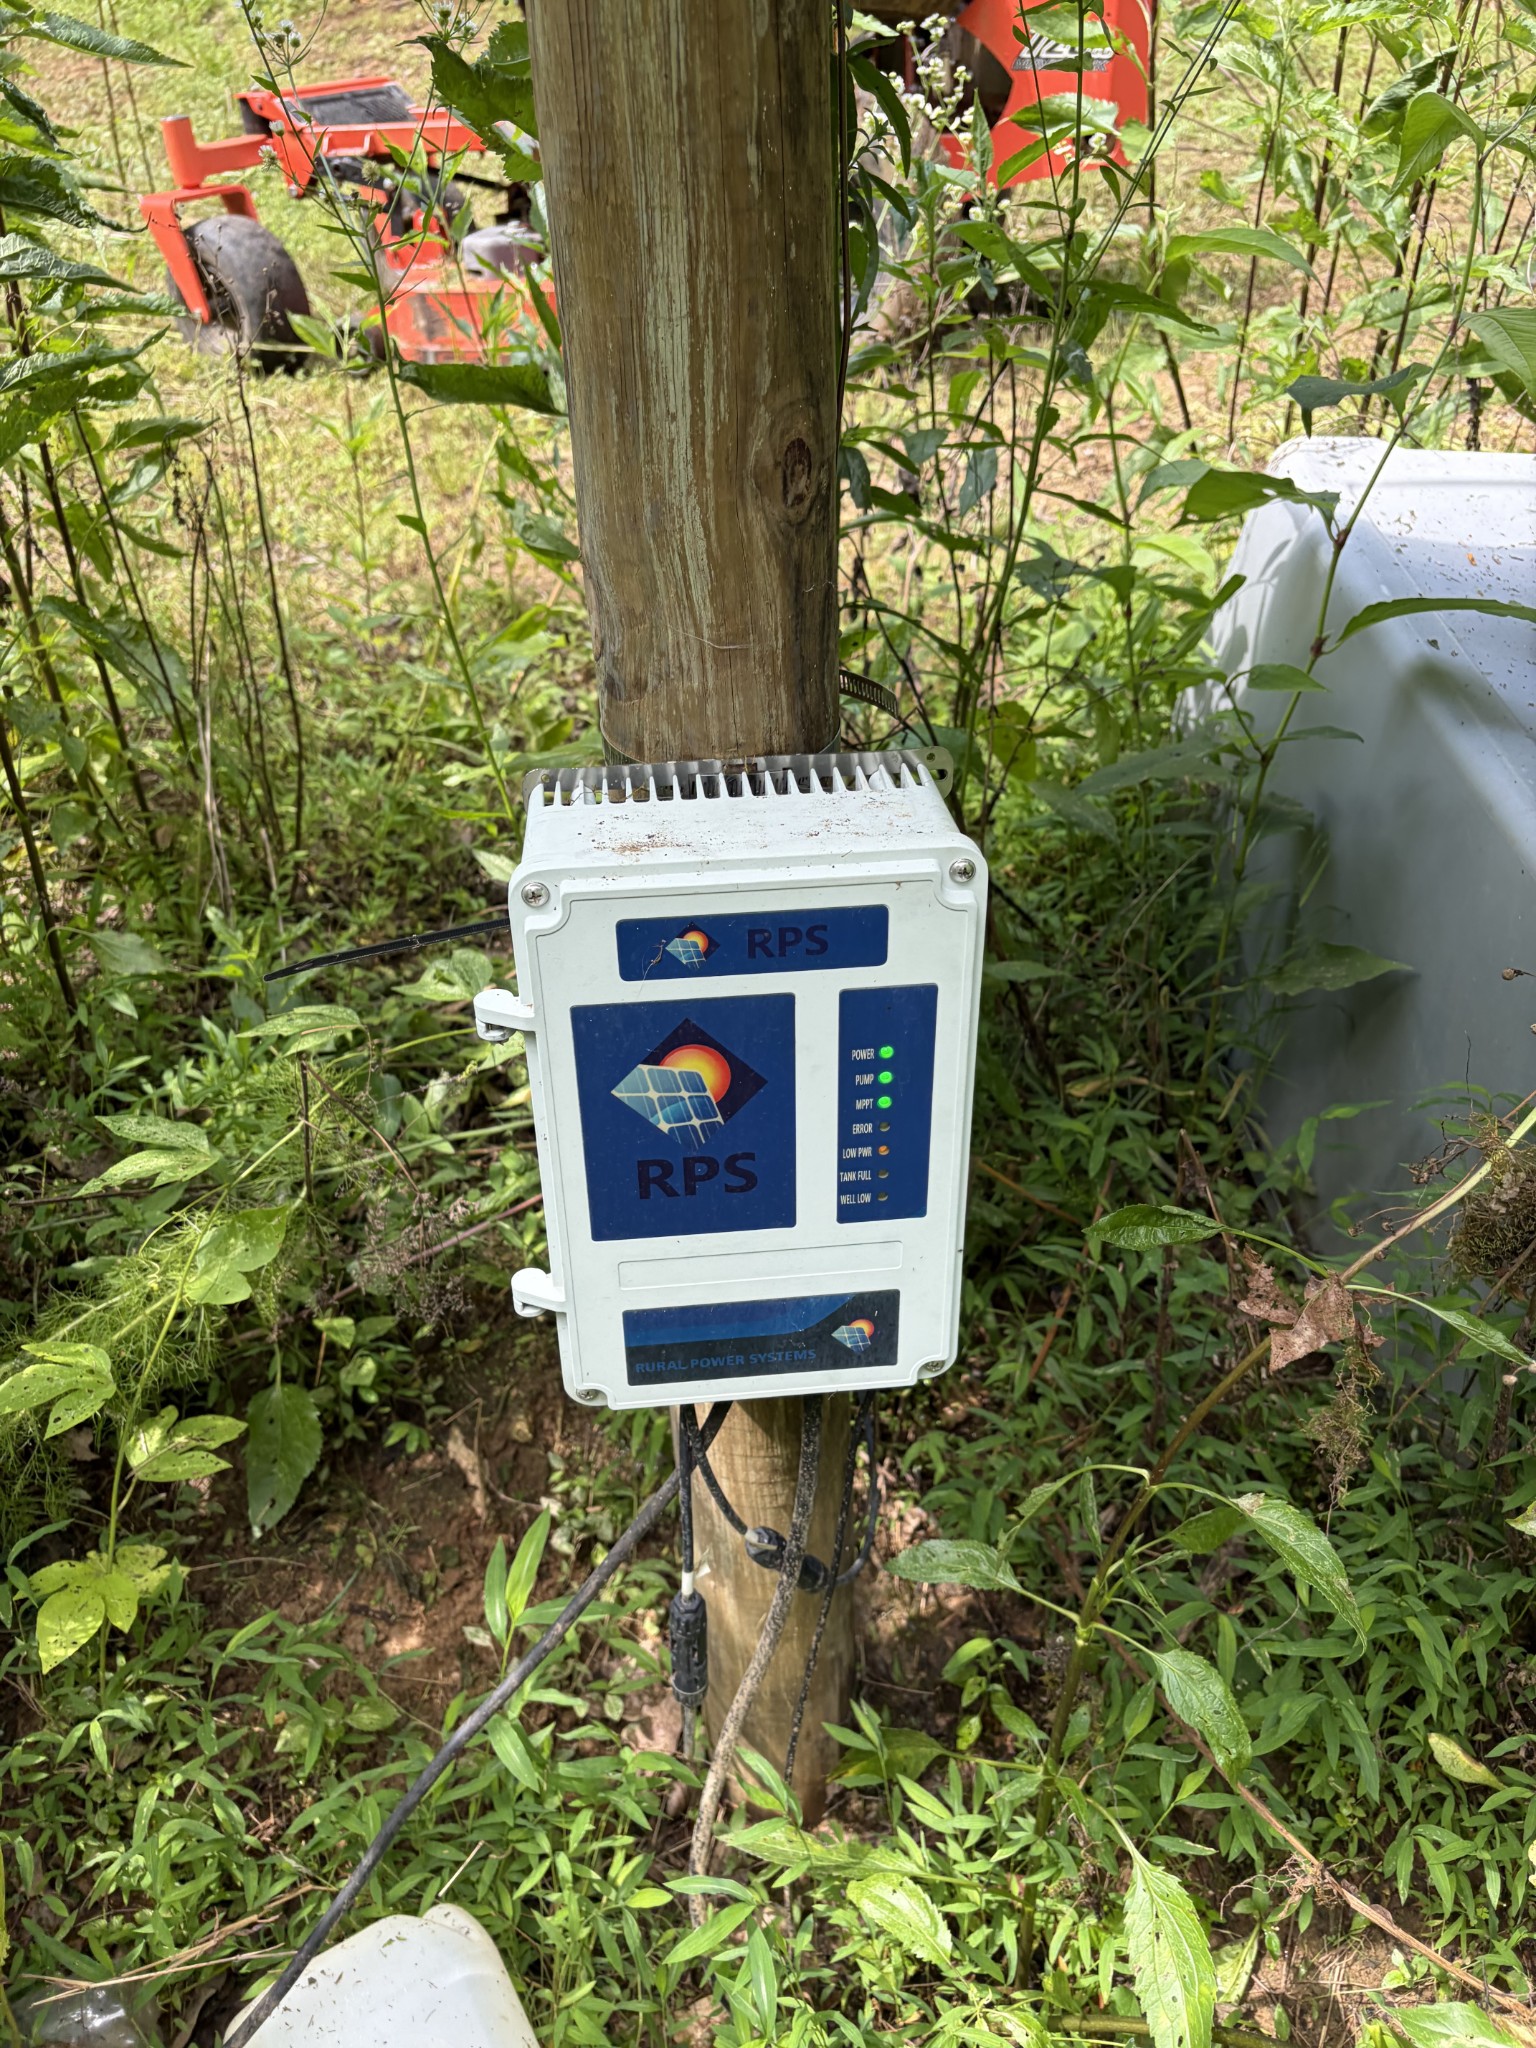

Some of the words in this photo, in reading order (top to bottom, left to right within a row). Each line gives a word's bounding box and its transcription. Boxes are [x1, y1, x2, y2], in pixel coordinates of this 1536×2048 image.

[747, 924, 829, 960] RPS
[851, 1048, 875, 1061] POWER
[855, 1074, 874, 1086] PUMP
[855, 1098, 874, 1110] MPPT
[852, 1122, 873, 1135] ERROR
[842, 1148, 857, 1159] LOW
[858, 1147, 873, 1158] PWR
[637, 1152, 758, 1199] RPS
[840, 1171, 857, 1182] TANK
[858, 1170, 872, 1181] FULL
[840, 1194, 856, 1205] WELL
[857, 1193, 872, 1204] LOW
[635, 1361, 687, 1373] RURAL
[690, 1354, 745, 1369] POWER
[749, 1349, 817, 1365] SYSTEMS
